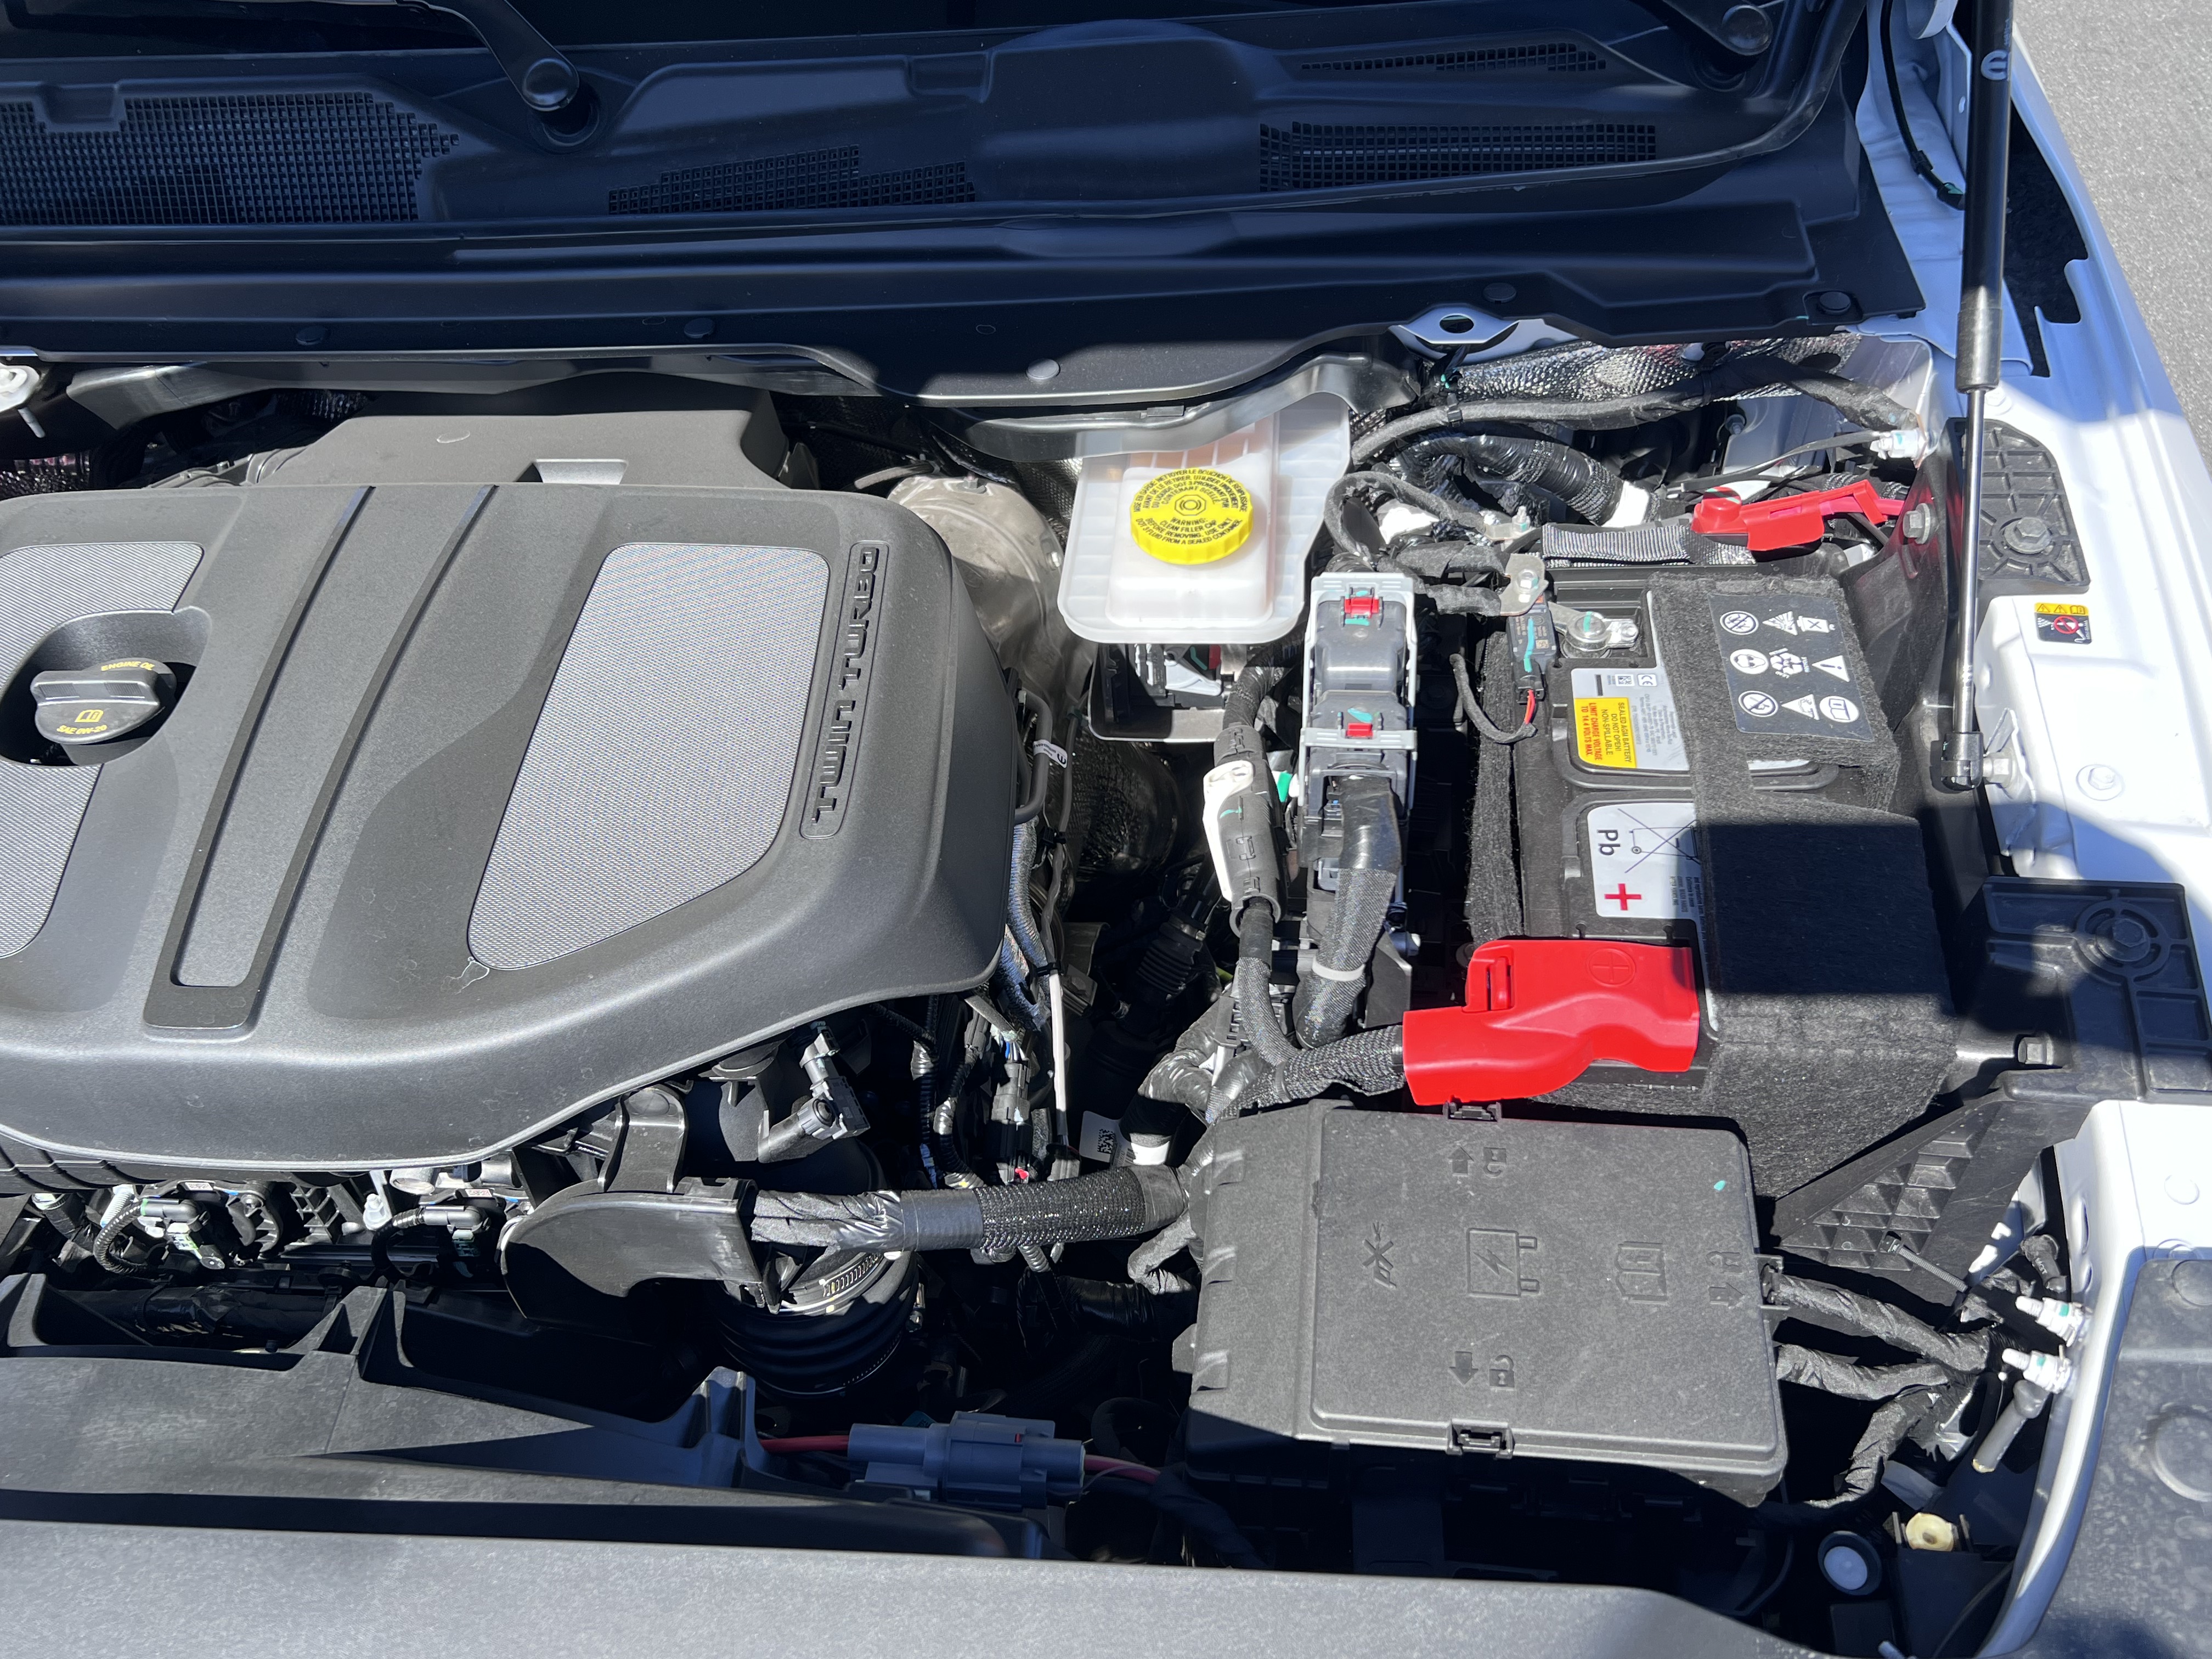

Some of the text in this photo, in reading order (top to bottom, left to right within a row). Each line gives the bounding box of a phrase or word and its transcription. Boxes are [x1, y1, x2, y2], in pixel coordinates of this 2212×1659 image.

[1155, 470, 1187, 483] NETTOYER
[1198, 470, 1228, 481] BOUCHON
[1143, 494, 1153, 509] AVANT
[1193, 475, 1221, 485] UTILISER
[1154, 486, 1174, 501] LIQUIDE
[1194, 481, 1228, 497] PROVENANT
[1161, 486, 1198, 504] CONTENANT
[1136, 518, 1147, 527] DOT
[1146, 528, 1163, 539] FLUID
[1188, 537, 1212, 545] SEALED
[1146, 517, 1166, 533] BEFORE
[1217, 518, 1232, 529] ONLY
[1160, 520, 1180, 531] CLEAN
[1204, 520, 1216, 528] CAP
[101, 661, 155, 671] ENGINE OIL
[811, 547, 879, 823] TWIN TURBO
[1611, 713, 1618, 721] DO
[1618, 702, 1627, 724] SEALED
[57, 725, 108, 735] SAE 0W-20
[1583, 727, 1592, 743] VOLTS
[1589, 703, 1602, 760] LIMIT CHARGE VOLTAGE
[1601, 709, 1613, 755] NON-SPILLABLE
[1622, 738, 1632, 763] BATTERY
[1597, 830, 1621, 856] Pb
